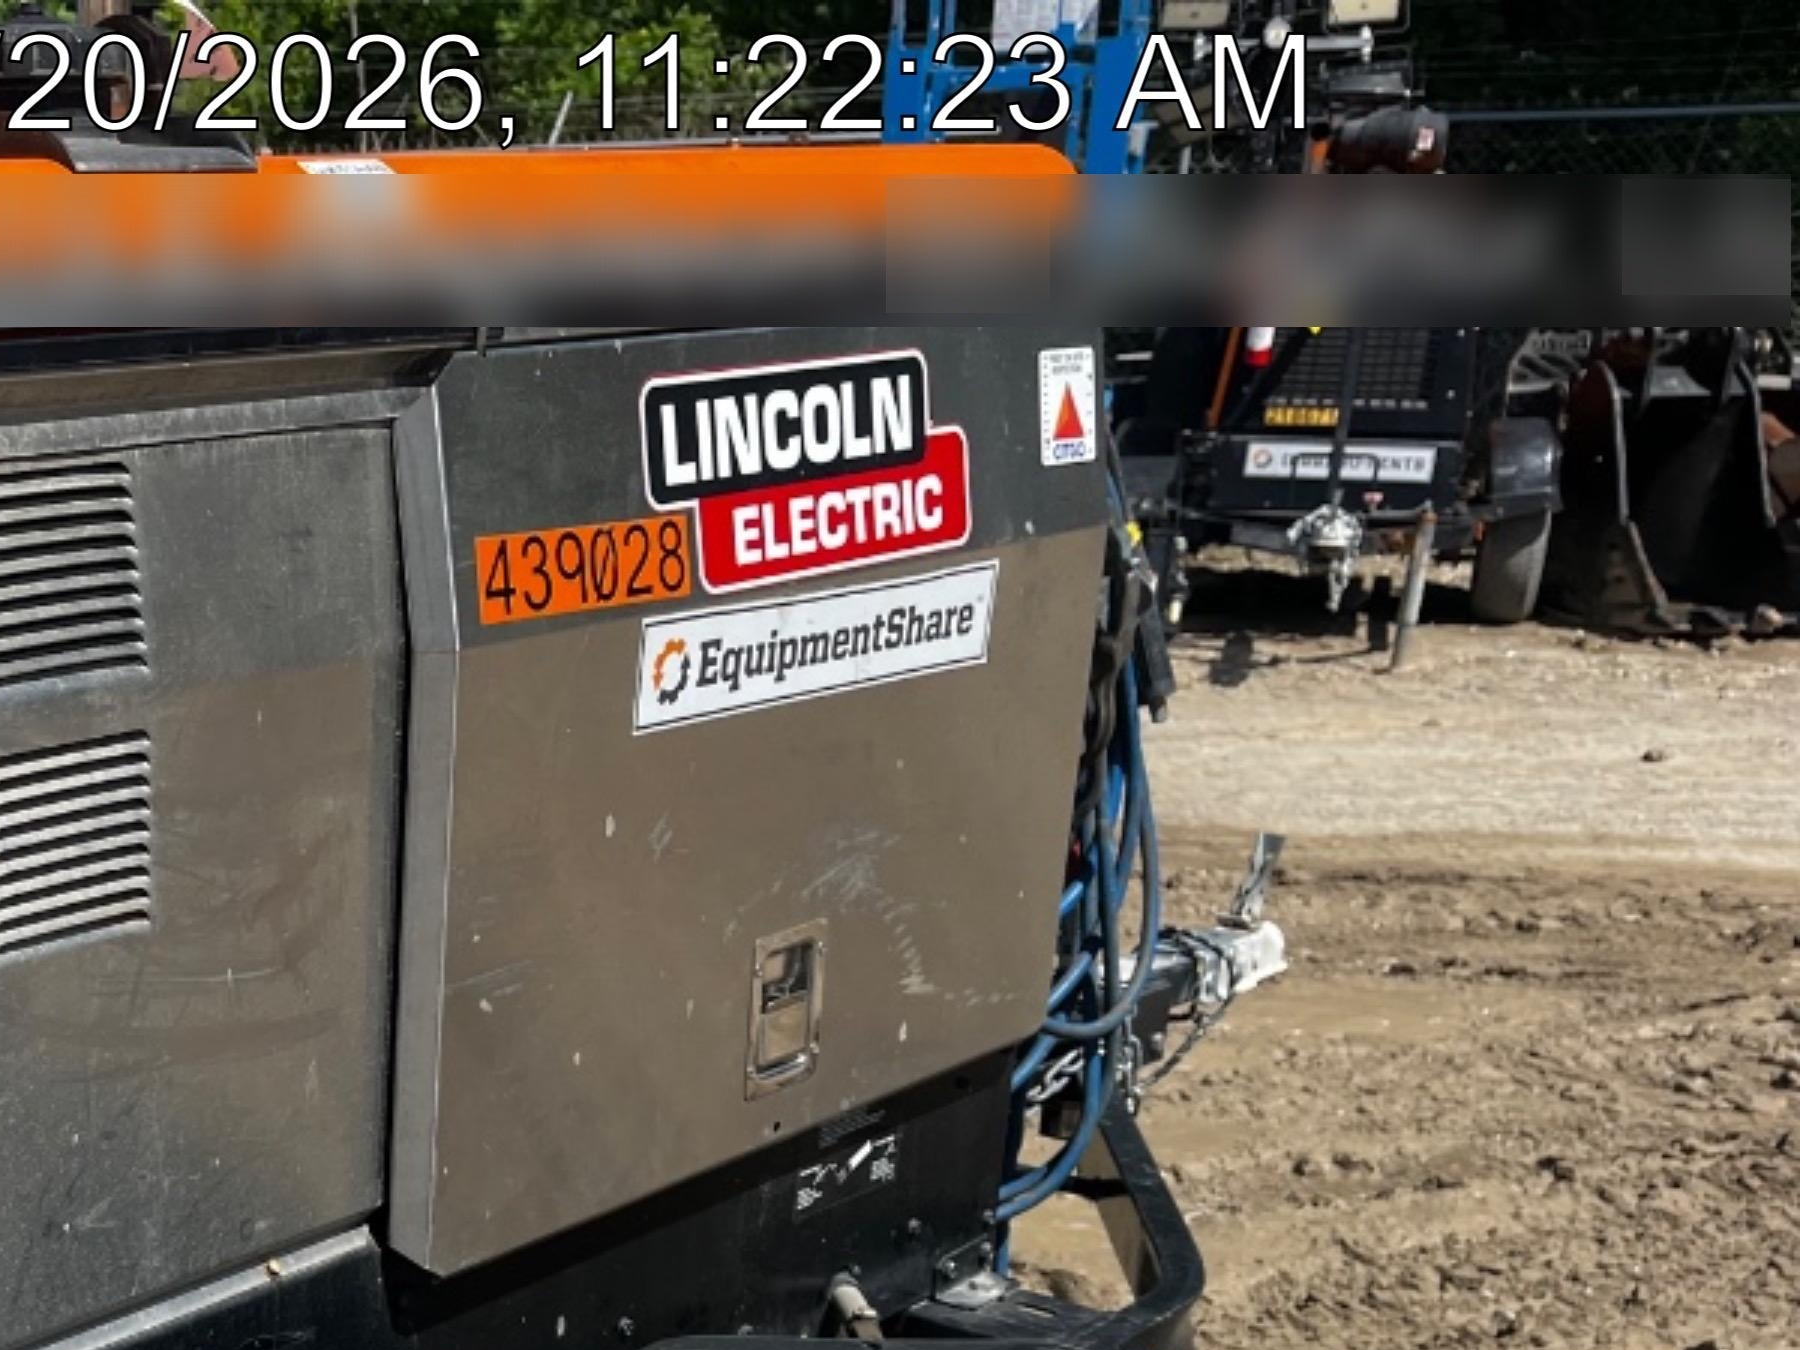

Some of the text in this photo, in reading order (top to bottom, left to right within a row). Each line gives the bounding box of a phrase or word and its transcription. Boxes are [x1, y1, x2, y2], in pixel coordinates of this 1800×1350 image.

[658, 374, 914, 487] LINCOLN
[482, 518, 687, 616] 439028
[731, 474, 944, 567] ELECTRIC
[695, 601, 974, 693] EquipmentShare
